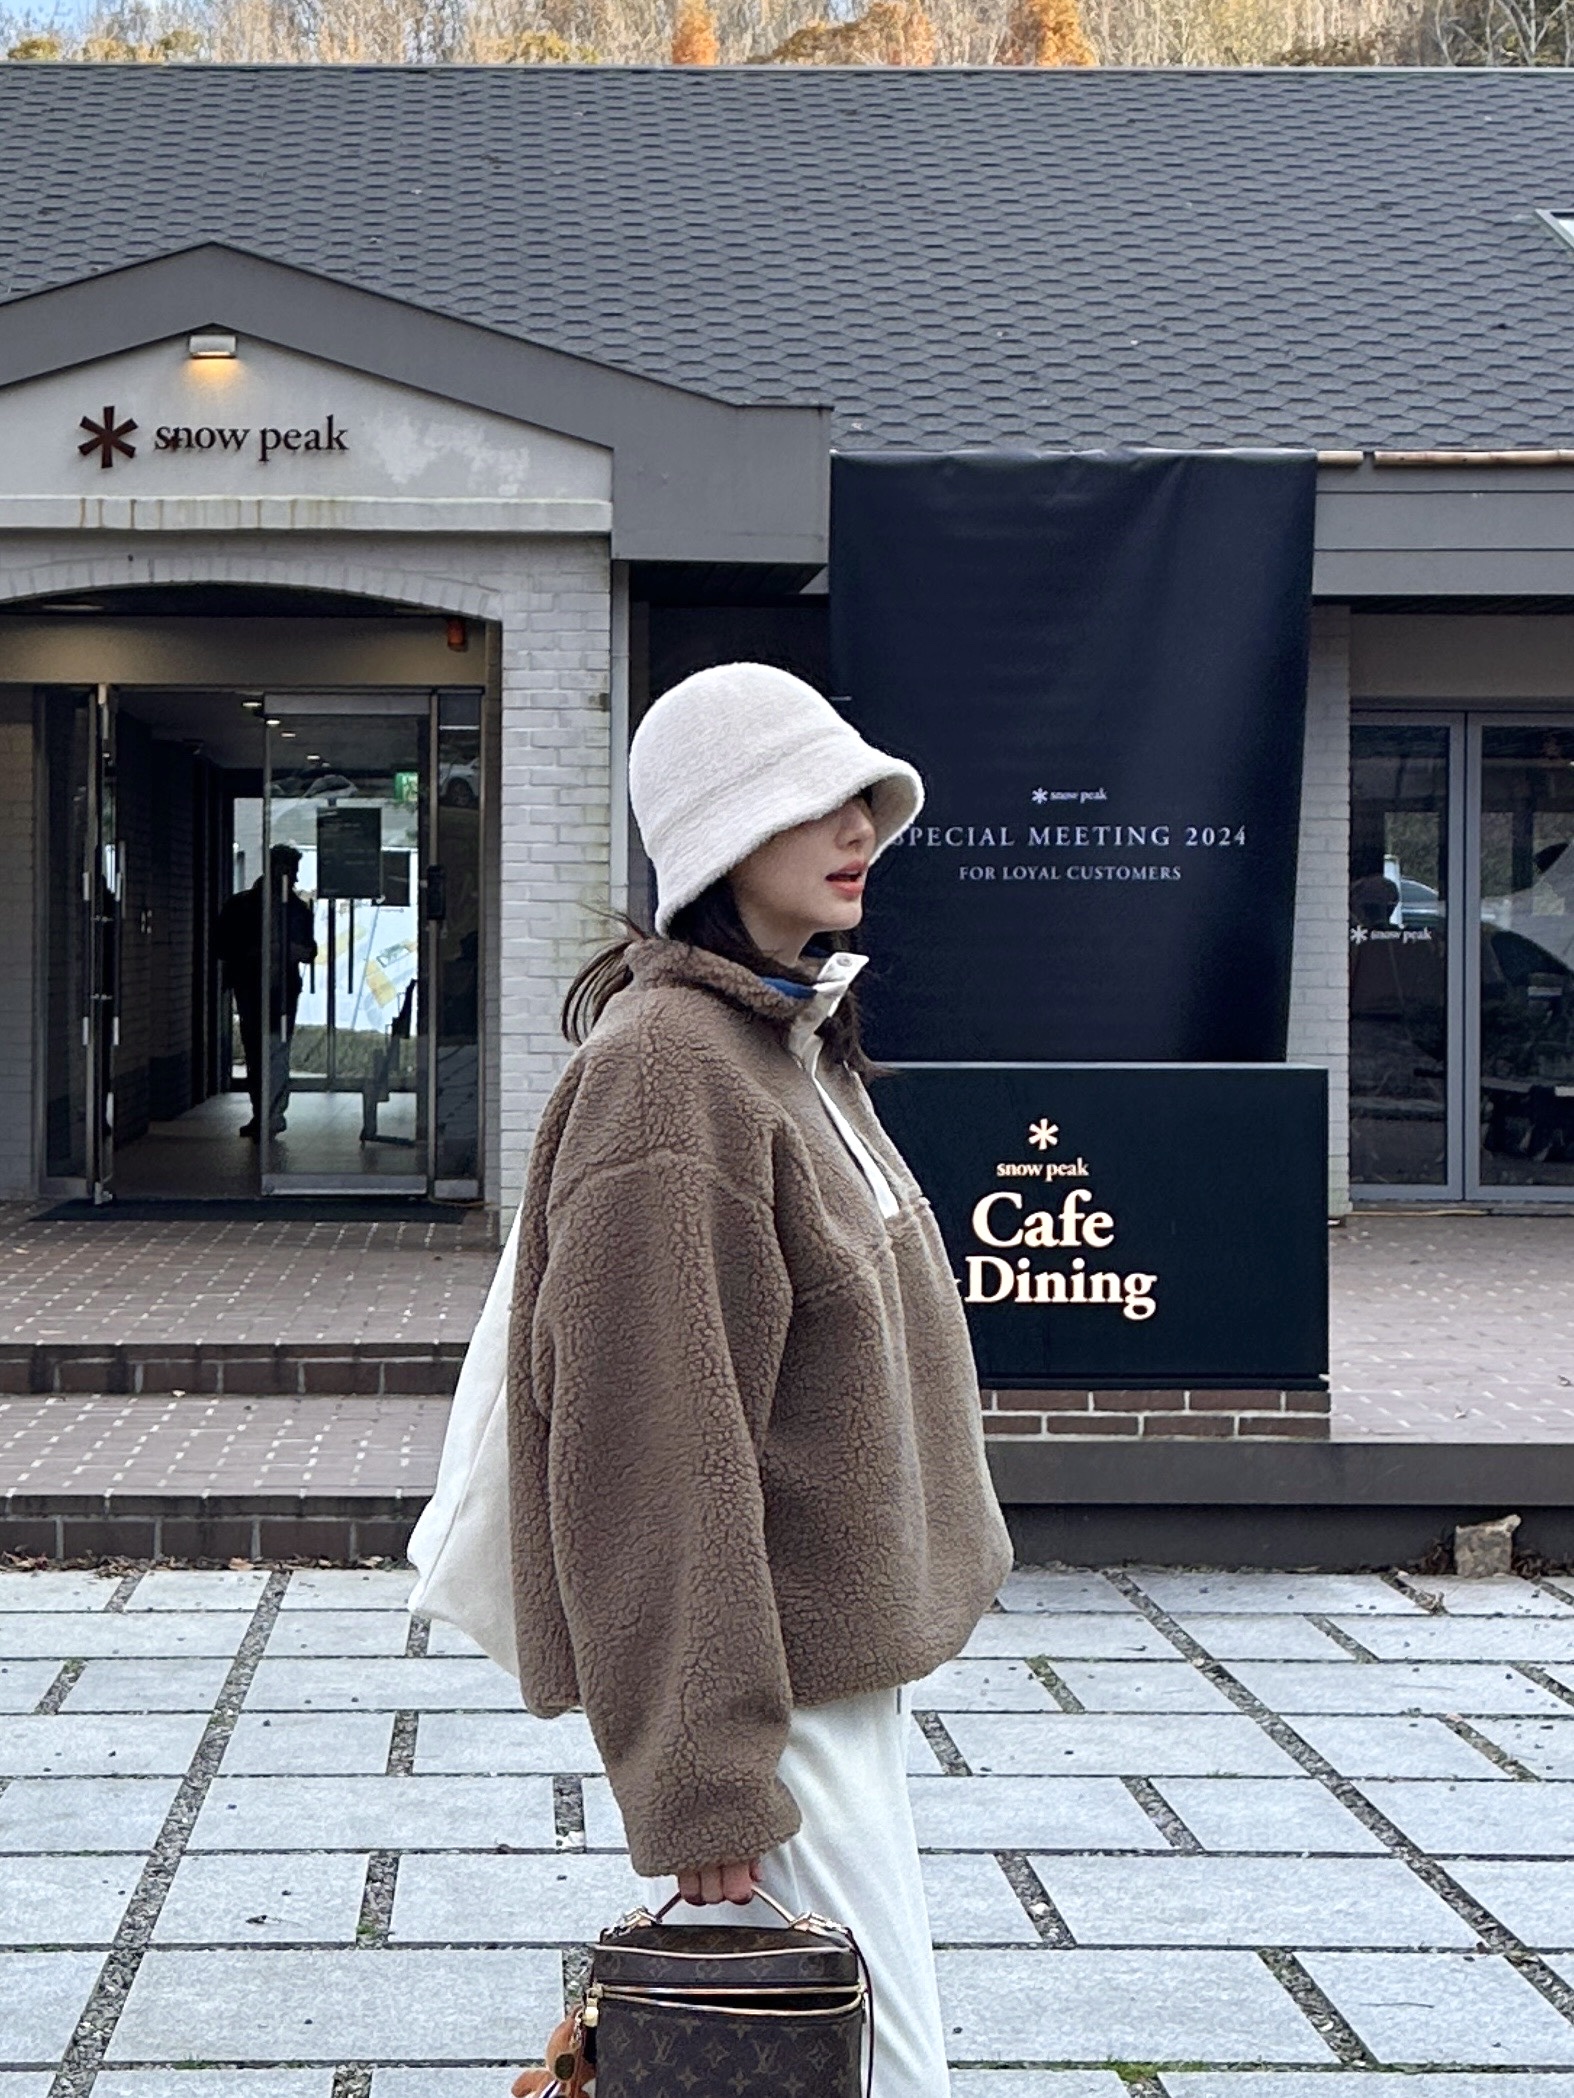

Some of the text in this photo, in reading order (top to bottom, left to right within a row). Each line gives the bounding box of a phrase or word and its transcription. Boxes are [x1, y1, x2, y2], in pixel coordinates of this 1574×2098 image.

[154, 414, 350, 462] snow peak
[1028, 826, 1171, 847] MEETING
[1185, 826, 1246, 847] 2024
[959, 866, 1181, 881] FOR LOYAL CUSTOMERS
[996, 1157, 1089, 1182] snow peak
[972, 1189, 1115, 1248] Cafe
[964, 1256, 1158, 1321] Dining
